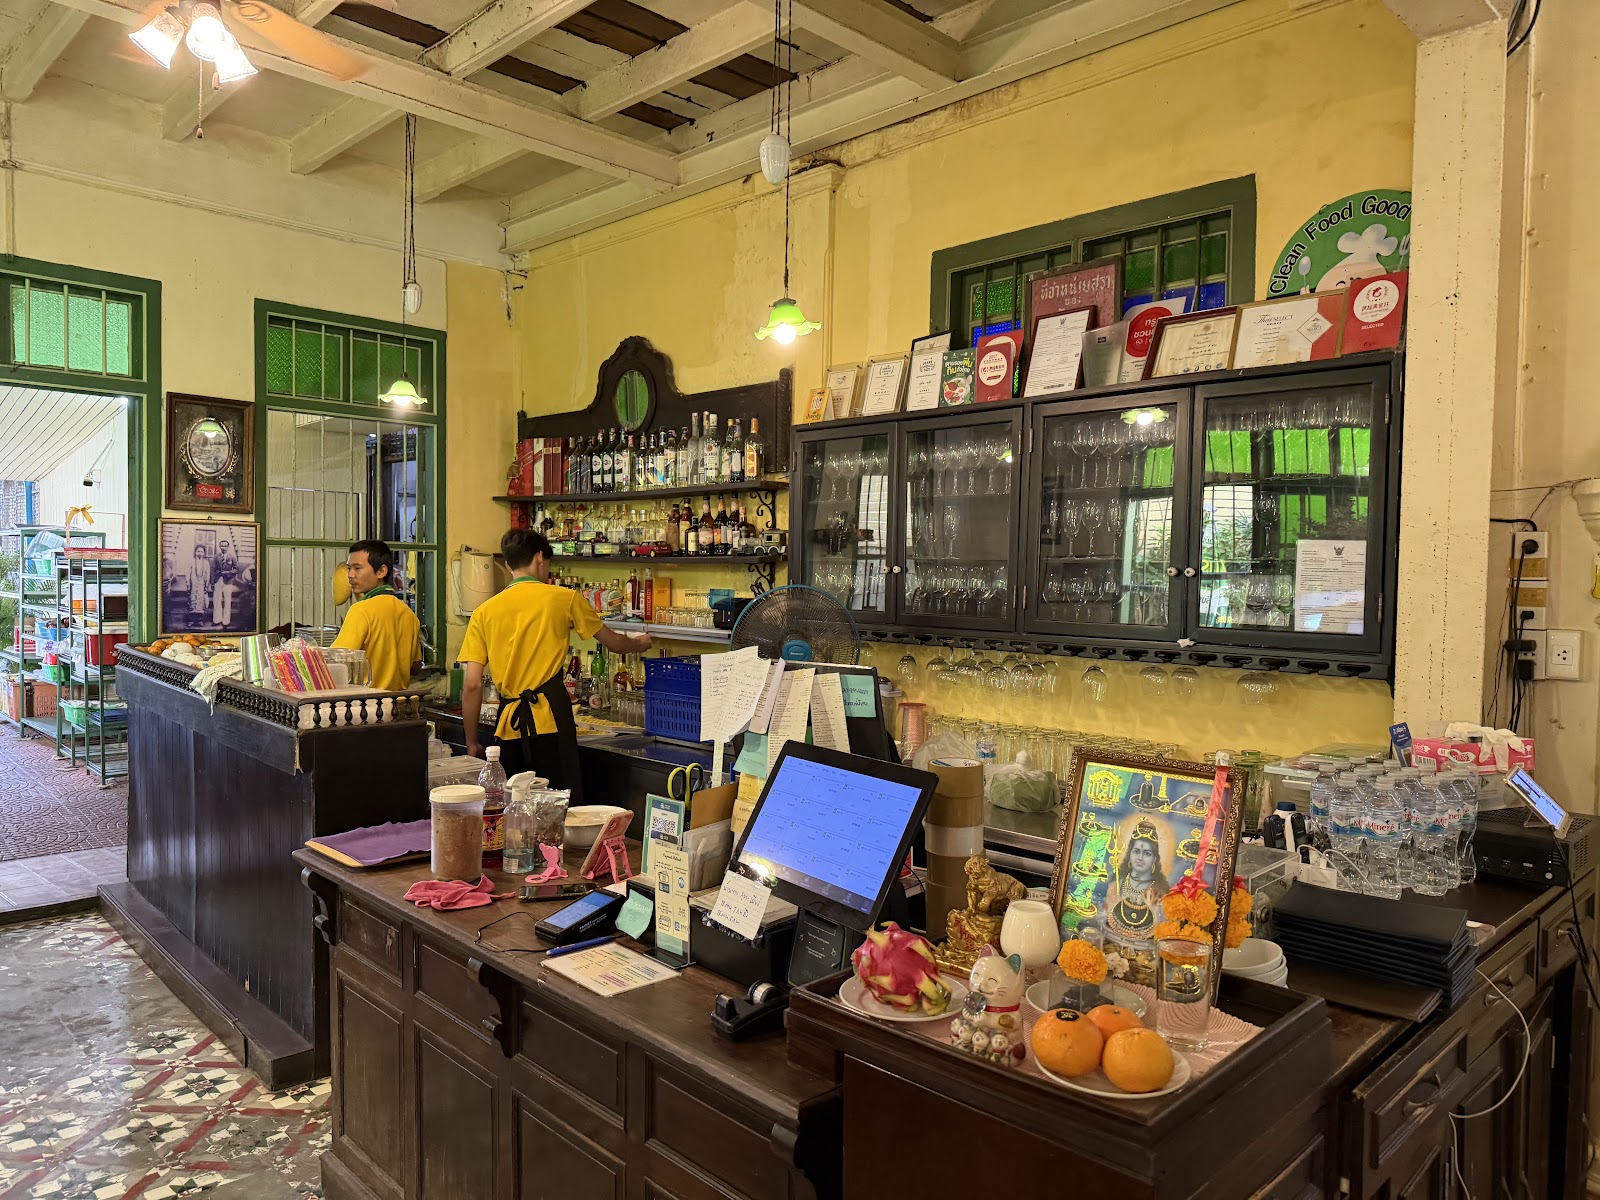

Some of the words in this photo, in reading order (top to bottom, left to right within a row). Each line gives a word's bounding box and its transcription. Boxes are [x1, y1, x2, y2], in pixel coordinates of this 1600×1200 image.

[1269, 242, 1307, 294] Clean
[1304, 201, 1353, 241] Food
[1366, 821, 1395, 833] Mineré
